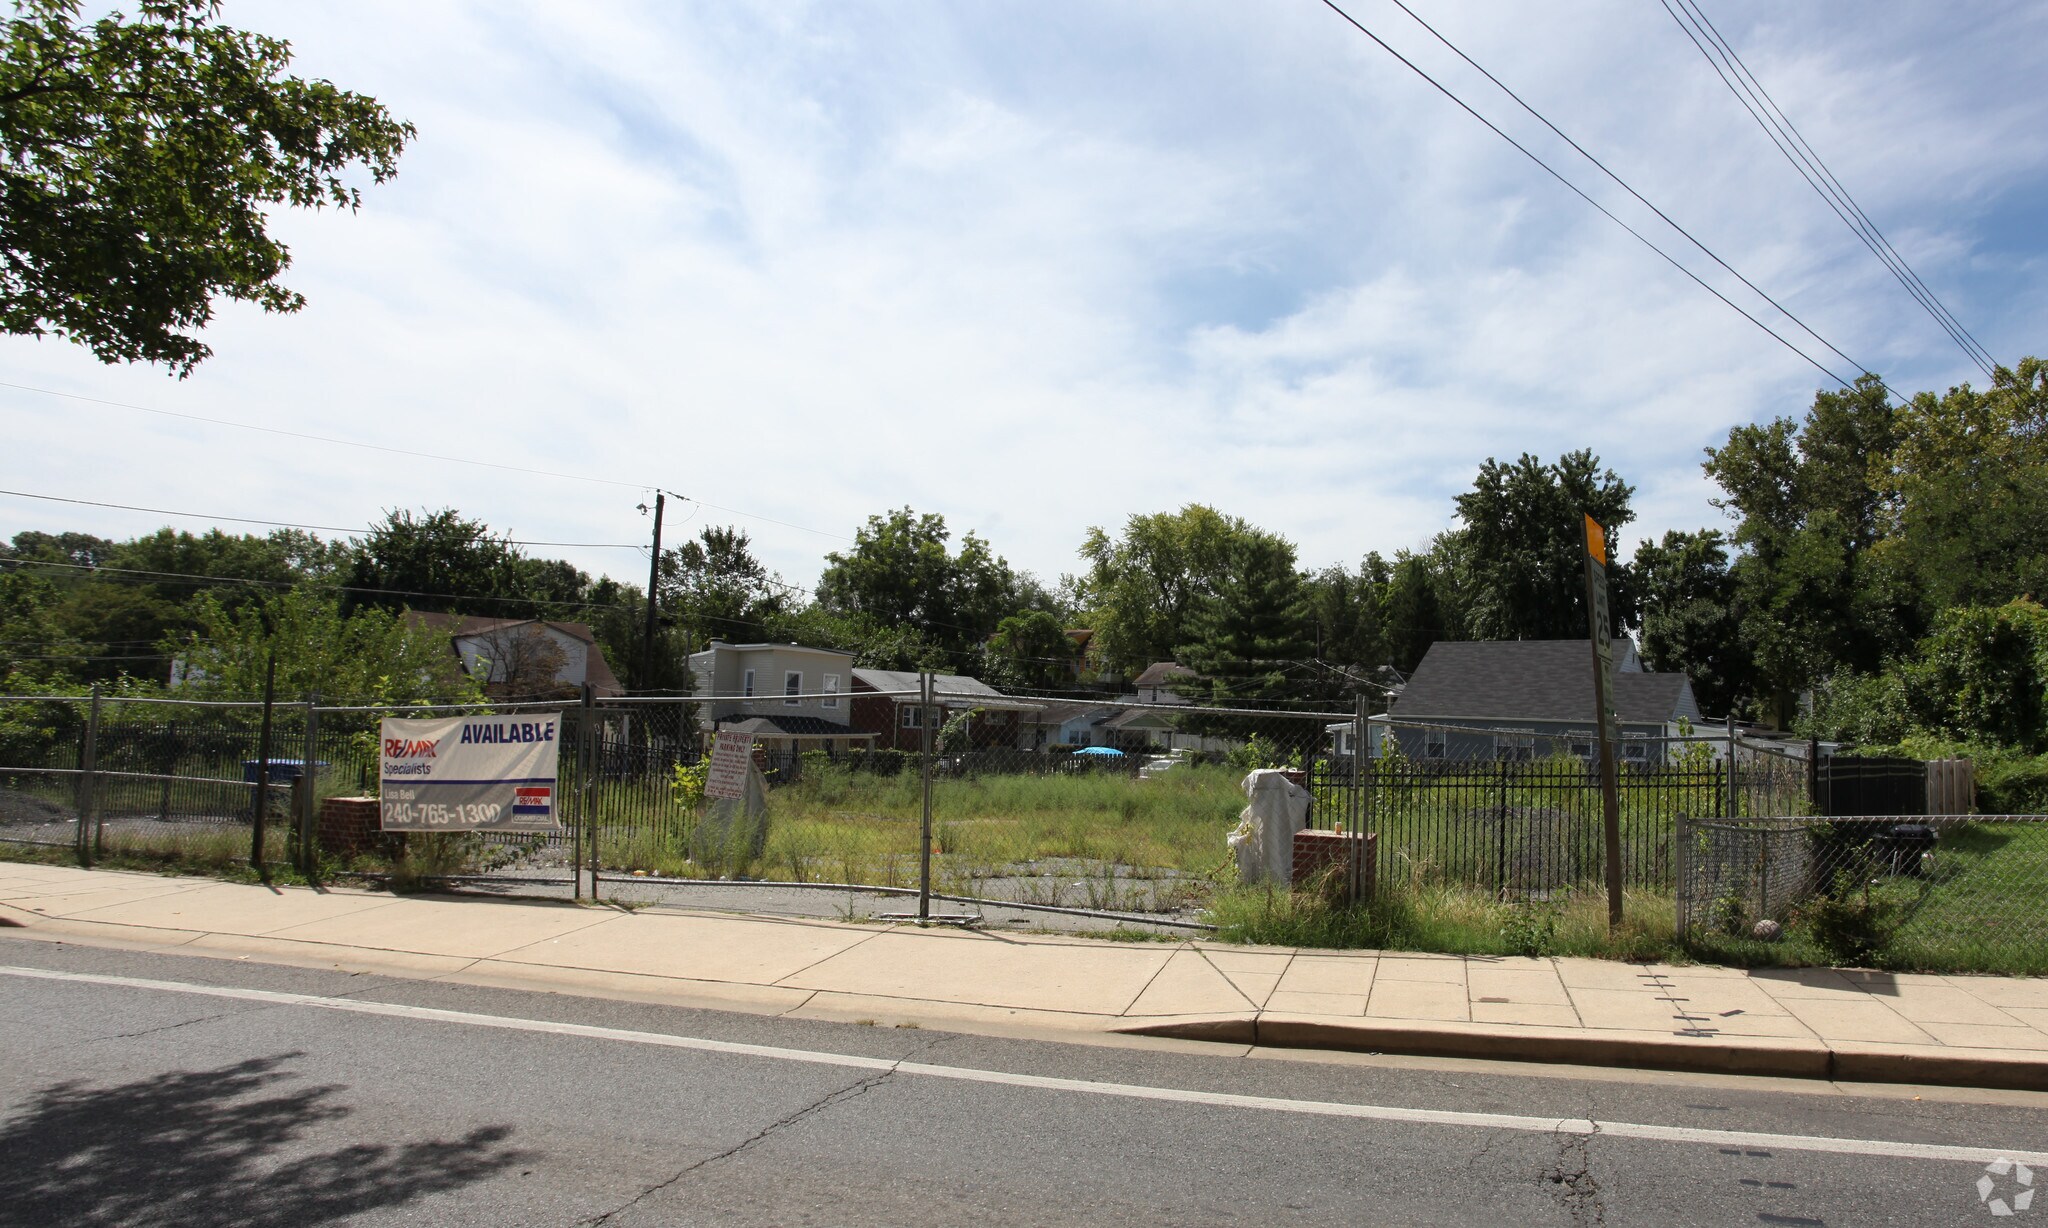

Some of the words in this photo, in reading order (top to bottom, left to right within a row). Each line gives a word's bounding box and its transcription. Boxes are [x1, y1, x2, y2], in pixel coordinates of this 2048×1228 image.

[1597, 610, 1611, 650] 25
[461, 722, 554, 744] AVAILABLE
[384, 738, 440, 758] RE/MAX
[384, 762, 432, 776] Specialists
[384, 788, 399, 800] Lisa
[400, 789, 415, 800] Bell
[385, 803, 501, 824] 240-765-1300
